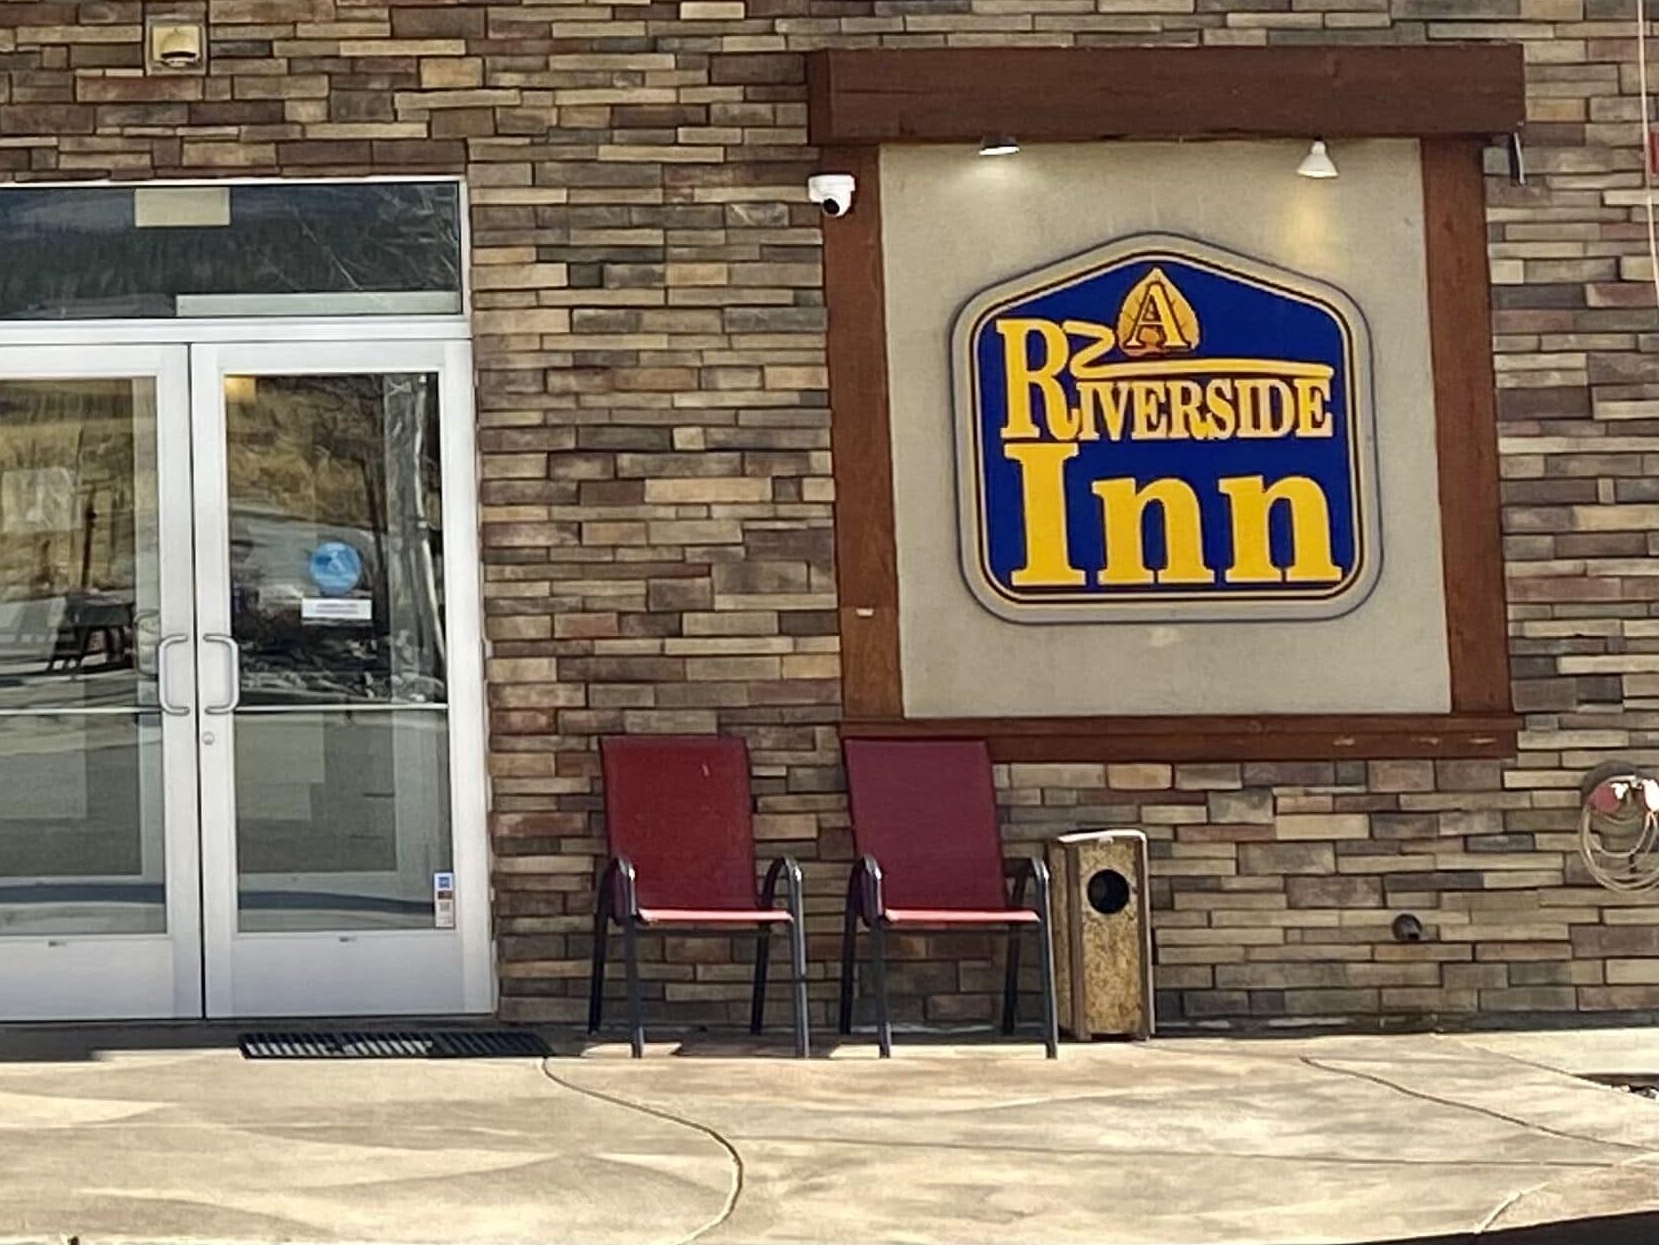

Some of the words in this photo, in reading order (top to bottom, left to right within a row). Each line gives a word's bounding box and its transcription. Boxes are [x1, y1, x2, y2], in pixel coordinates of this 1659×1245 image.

[1124, 279, 1192, 350] A
[995, 318, 1334, 441] RIVERSIDE
[1003, 441, 1343, 587] Inn
